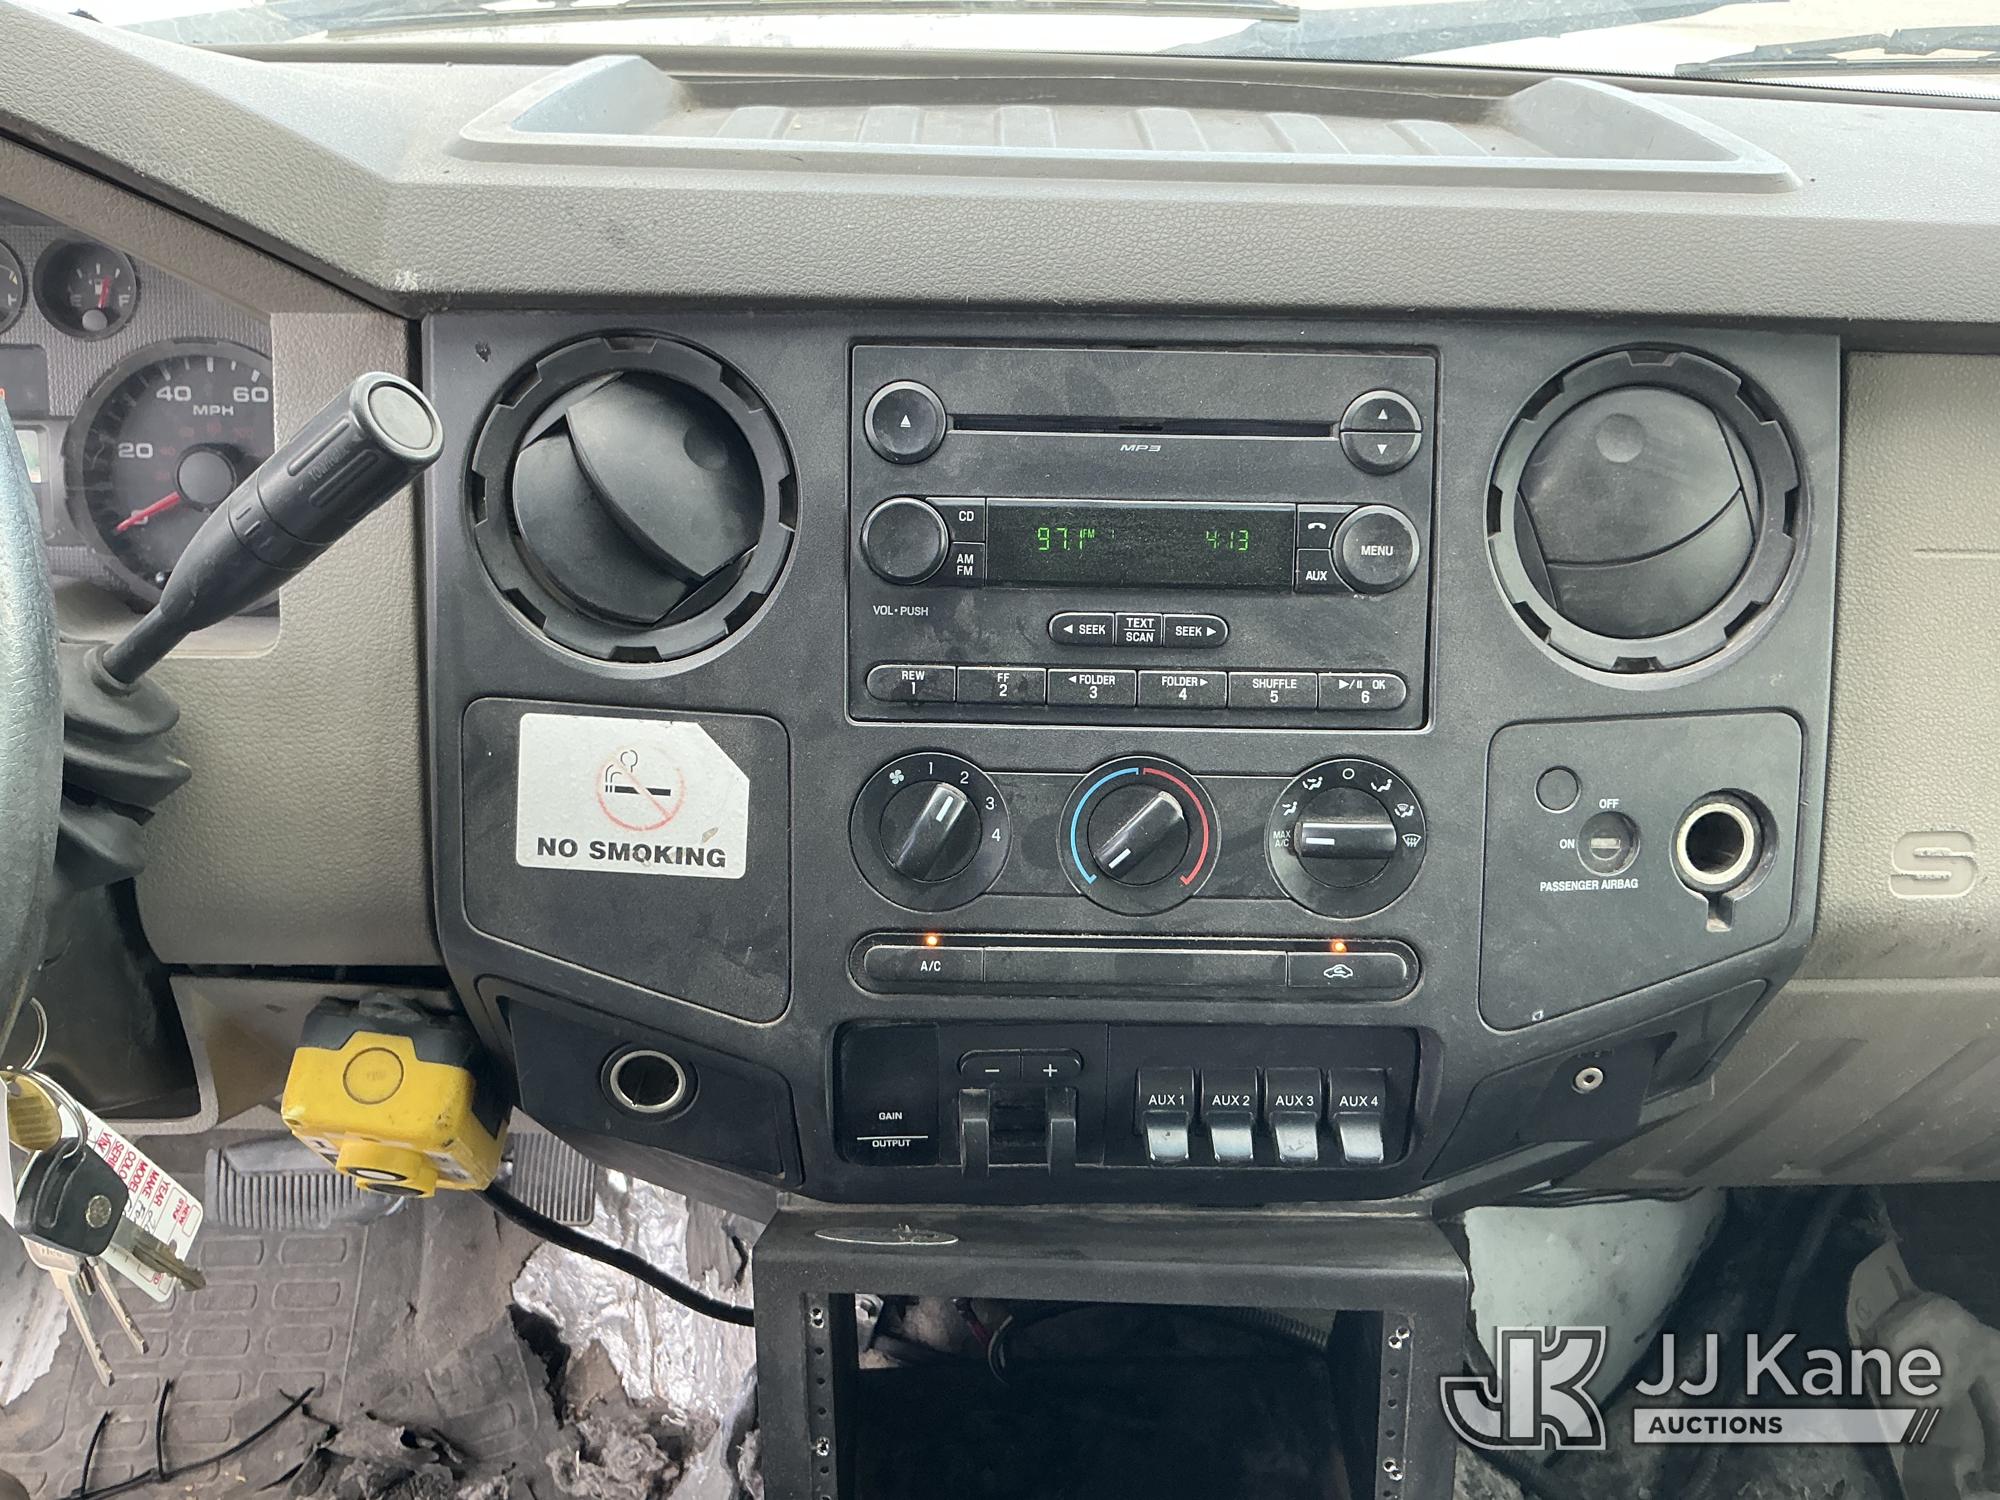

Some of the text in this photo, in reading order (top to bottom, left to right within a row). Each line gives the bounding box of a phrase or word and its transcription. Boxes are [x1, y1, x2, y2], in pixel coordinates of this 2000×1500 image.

[118, 294, 131, 308] F
[156, 386, 192, 402] 40
[233, 387, 269, 403] 60
[192, 404, 234, 416] MPH
[118, 443, 153, 459] 20
[1119, 443, 1162, 453] MP3
[958, 510, 975, 522] CD
[1361, 545, 1394, 557] MENU
[956, 553, 974, 565] AM
[956, 565, 973, 576] FM
[1305, 570, 1328, 581] AUX
[873, 605, 929, 617] VOL PUSH
[1126, 617, 1155, 629] TEXT
[1078, 624, 1106, 635] SEEK
[1175, 626, 1203, 637] SEEK
[1125, 631, 1154, 643] SCAN
[901, 670, 925, 681] REW
[997, 673, 1010, 683] FF
[1078, 674, 1116, 685] FOLDER
[1161, 677, 1198, 687] FOLDER
[1252, 678, 1297, 689] SHUFFLE
[1372, 680, 1386, 690] OK
[911, 683, 916, 695] 1
[999, 684, 1008, 697] 2
[1089, 686, 1098, 699] 3
[1179, 688, 1188, 701] 4
[1270, 690, 1279, 703] 5
[1361, 691, 1371, 704] 6
[928, 762, 934, 775] 1
[960, 771, 969, 785] 2
[985, 797, 995, 811] 3
[1599, 799, 1620, 809] OFF
[991, 828, 1001, 842] 4
[1273, 830, 1291, 839] MAX
[1274, 838, 1290, 848] A/C
[1559, 838, 1575, 849] ON
[537, 837, 727, 868] NO SMOKING
[1889, 829, 1978, 900] S
[1540, 878, 1639, 892] PASSENGER AIRBAG
[920, 960, 942, 972] A/C
[1148, 1095, 1185, 1106] AUX 1
[1212, 1095, 1250, 1106] AUX 2
[1275, 1095, 1314, 1106] AUX 3
[1339, 1096, 1379, 1107] AUX 4
[878, 1111, 903, 1121] GAIN
[872, 1139, 911, 1148] OUTPUT
[118, 1151, 136, 1180] COLO
[142, 1170, 160, 1199] MAKE
[153, 1180, 171, 1207] YEAR
